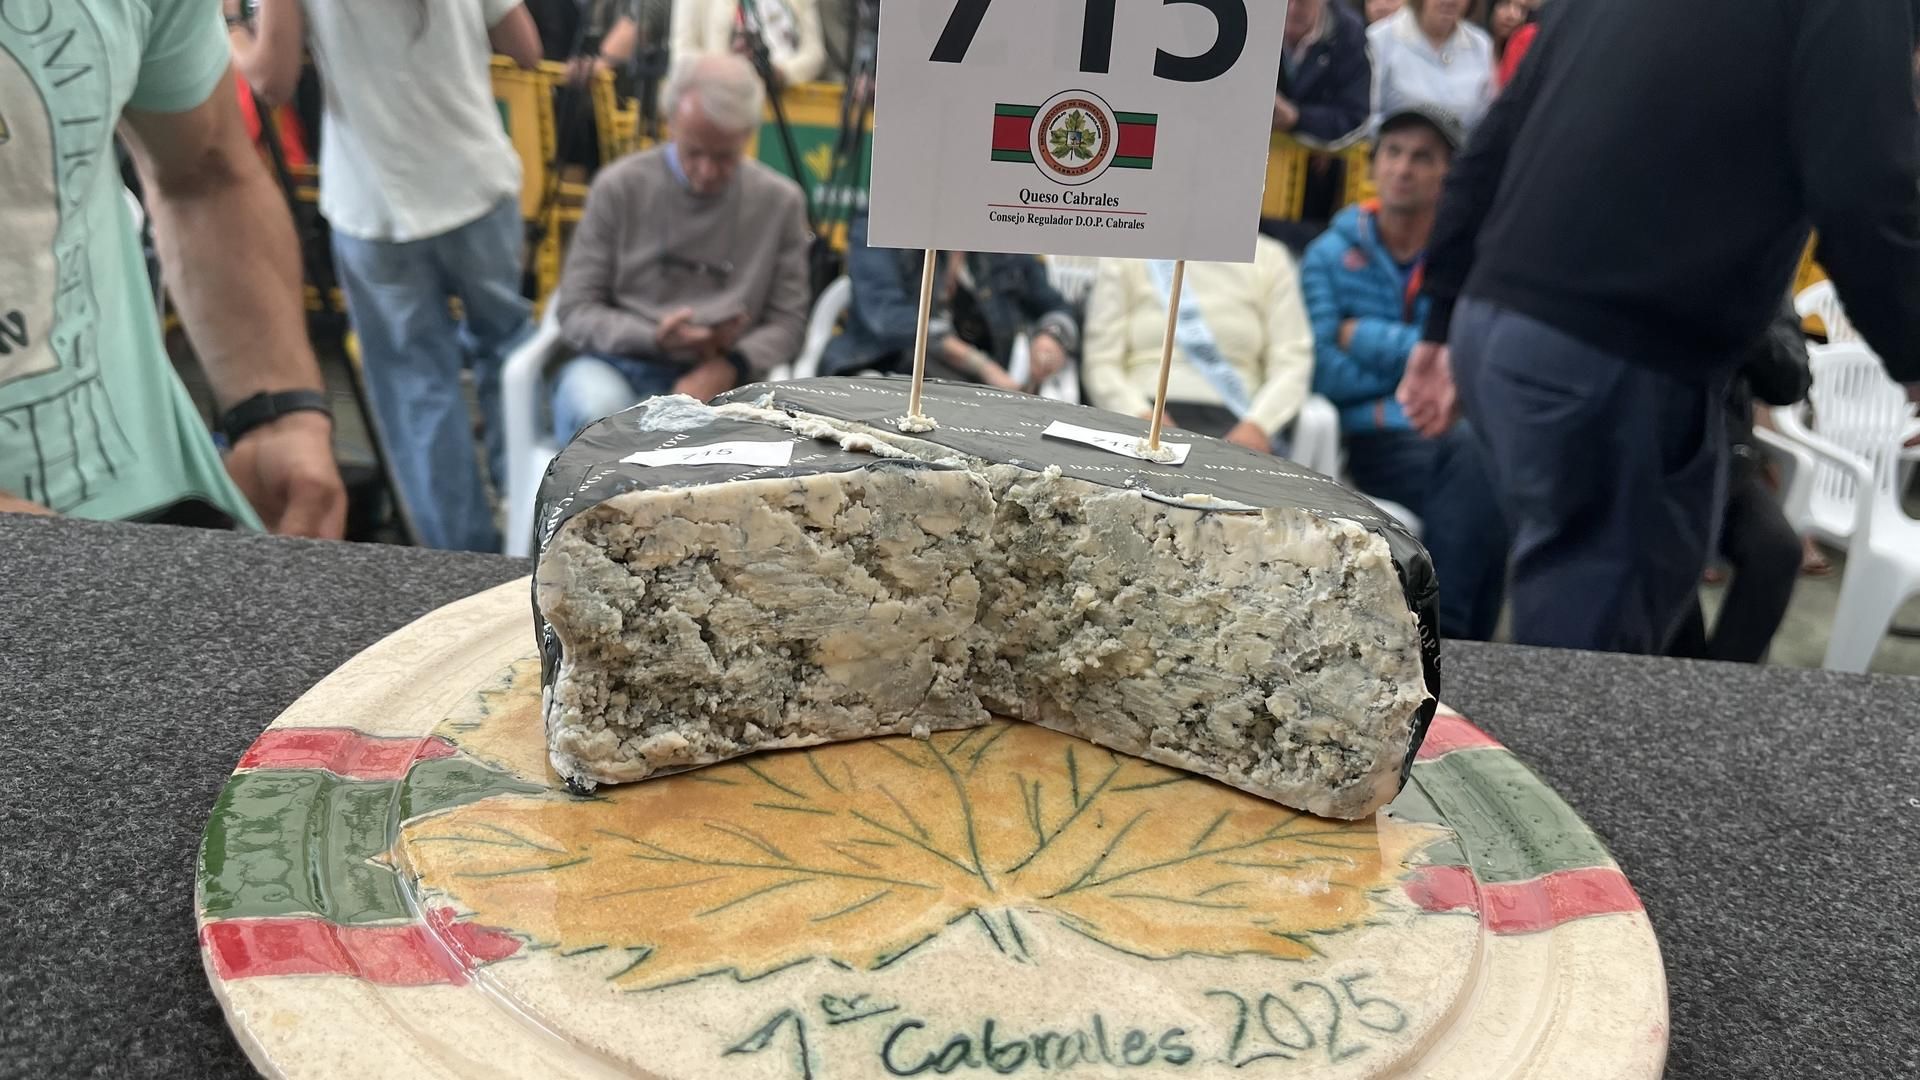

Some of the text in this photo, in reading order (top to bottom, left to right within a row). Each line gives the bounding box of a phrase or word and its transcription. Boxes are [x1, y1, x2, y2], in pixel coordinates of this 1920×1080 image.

[1019, 188, 1120, 207] Queso Cabrales
[989, 211, 1145, 230] Consejo Regulador D.O.P. Cabrales
[880, 1013, 1196, 1076] Cabrales
[1203, 971, 1408, 1069] 2025
